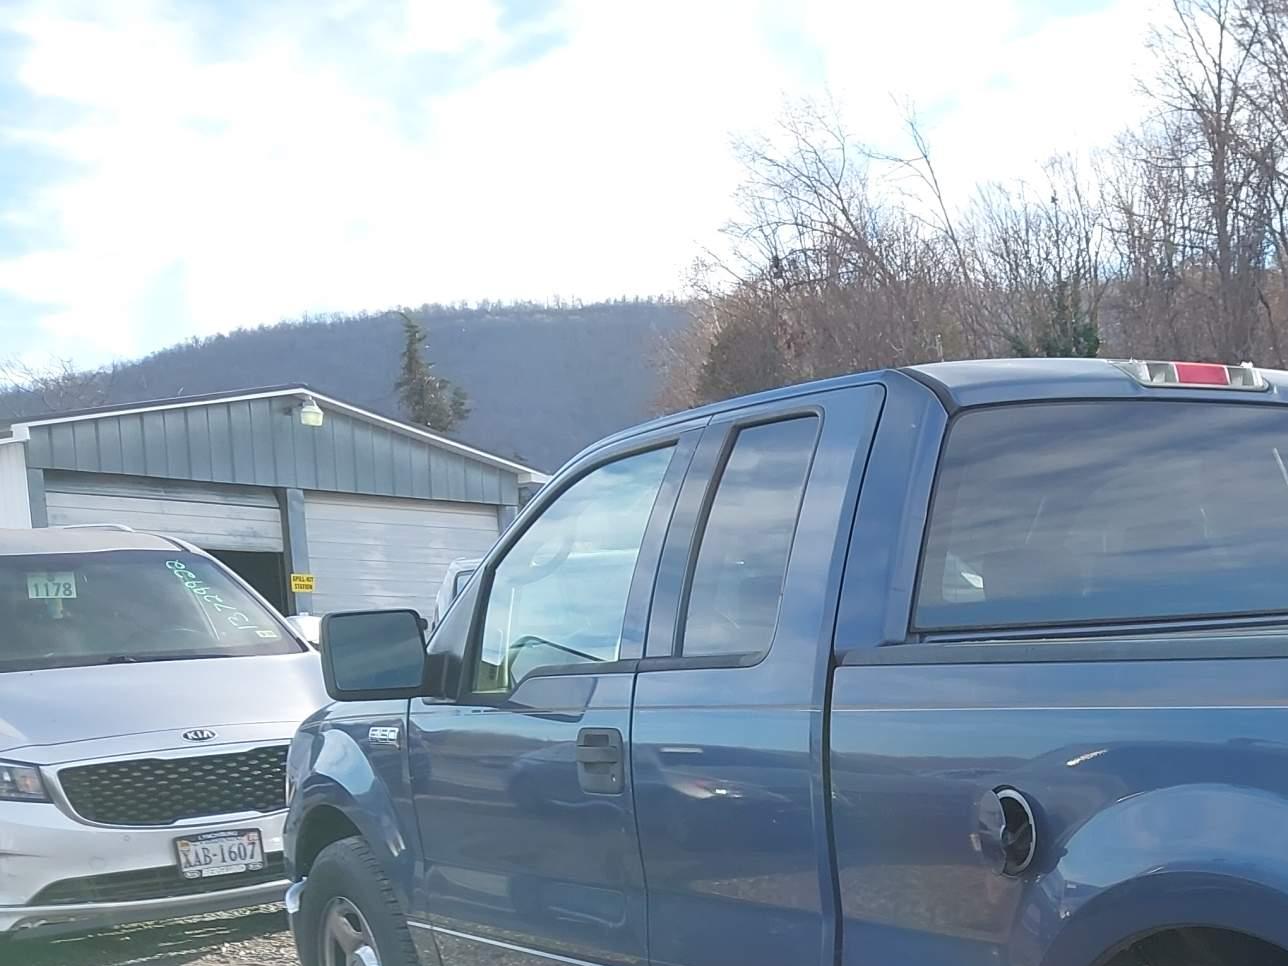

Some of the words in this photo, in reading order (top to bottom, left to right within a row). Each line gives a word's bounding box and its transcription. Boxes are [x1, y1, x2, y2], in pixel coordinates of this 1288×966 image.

[34, 582, 73, 597] 1178
[186, 730, 213, 739] KIA
[181, 841, 257, 869] XAB-1607
